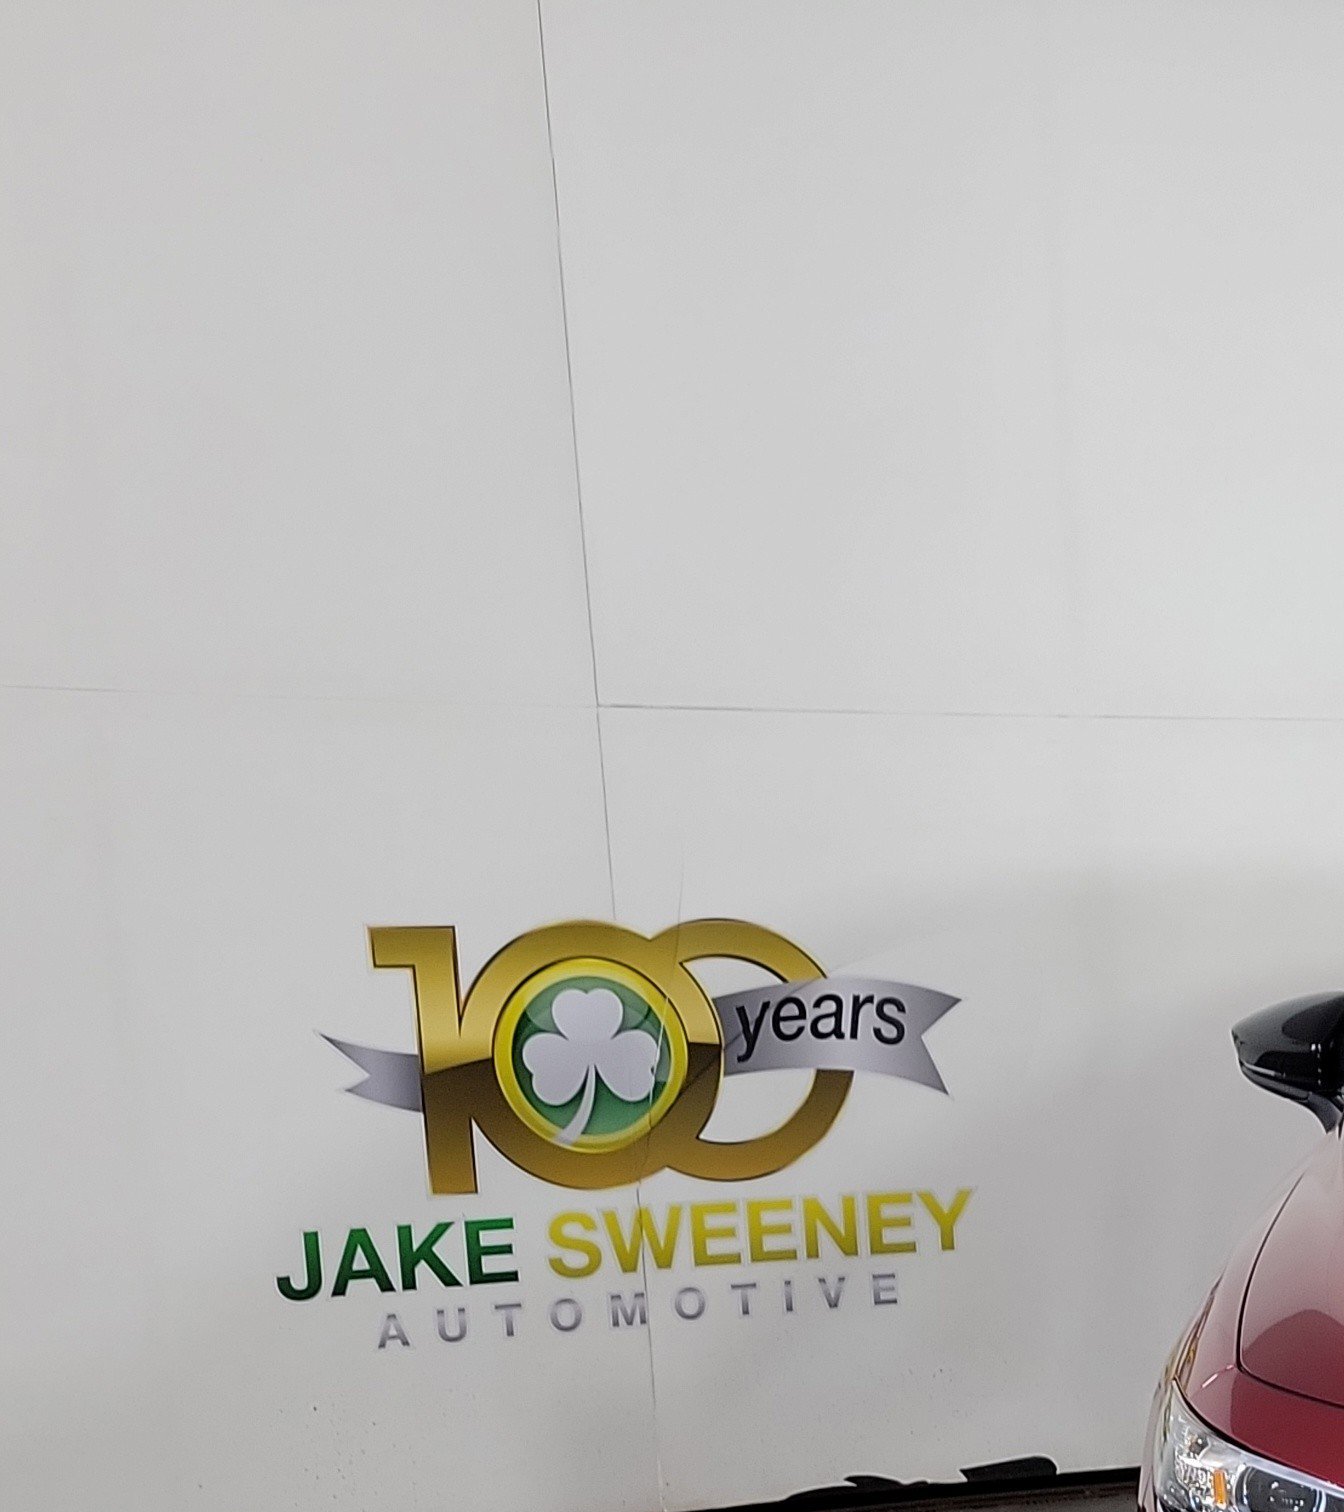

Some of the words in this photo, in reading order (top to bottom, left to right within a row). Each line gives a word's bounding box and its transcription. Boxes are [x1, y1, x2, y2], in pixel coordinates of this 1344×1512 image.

[368, 918, 855, 1196] 100
[735, 993, 907, 1063] years
[276, 1217, 520, 1302] JAKE
[546, 1190, 973, 1279] SWEENEY
[377, 1274, 899, 1350] AUTOMOTIVE
